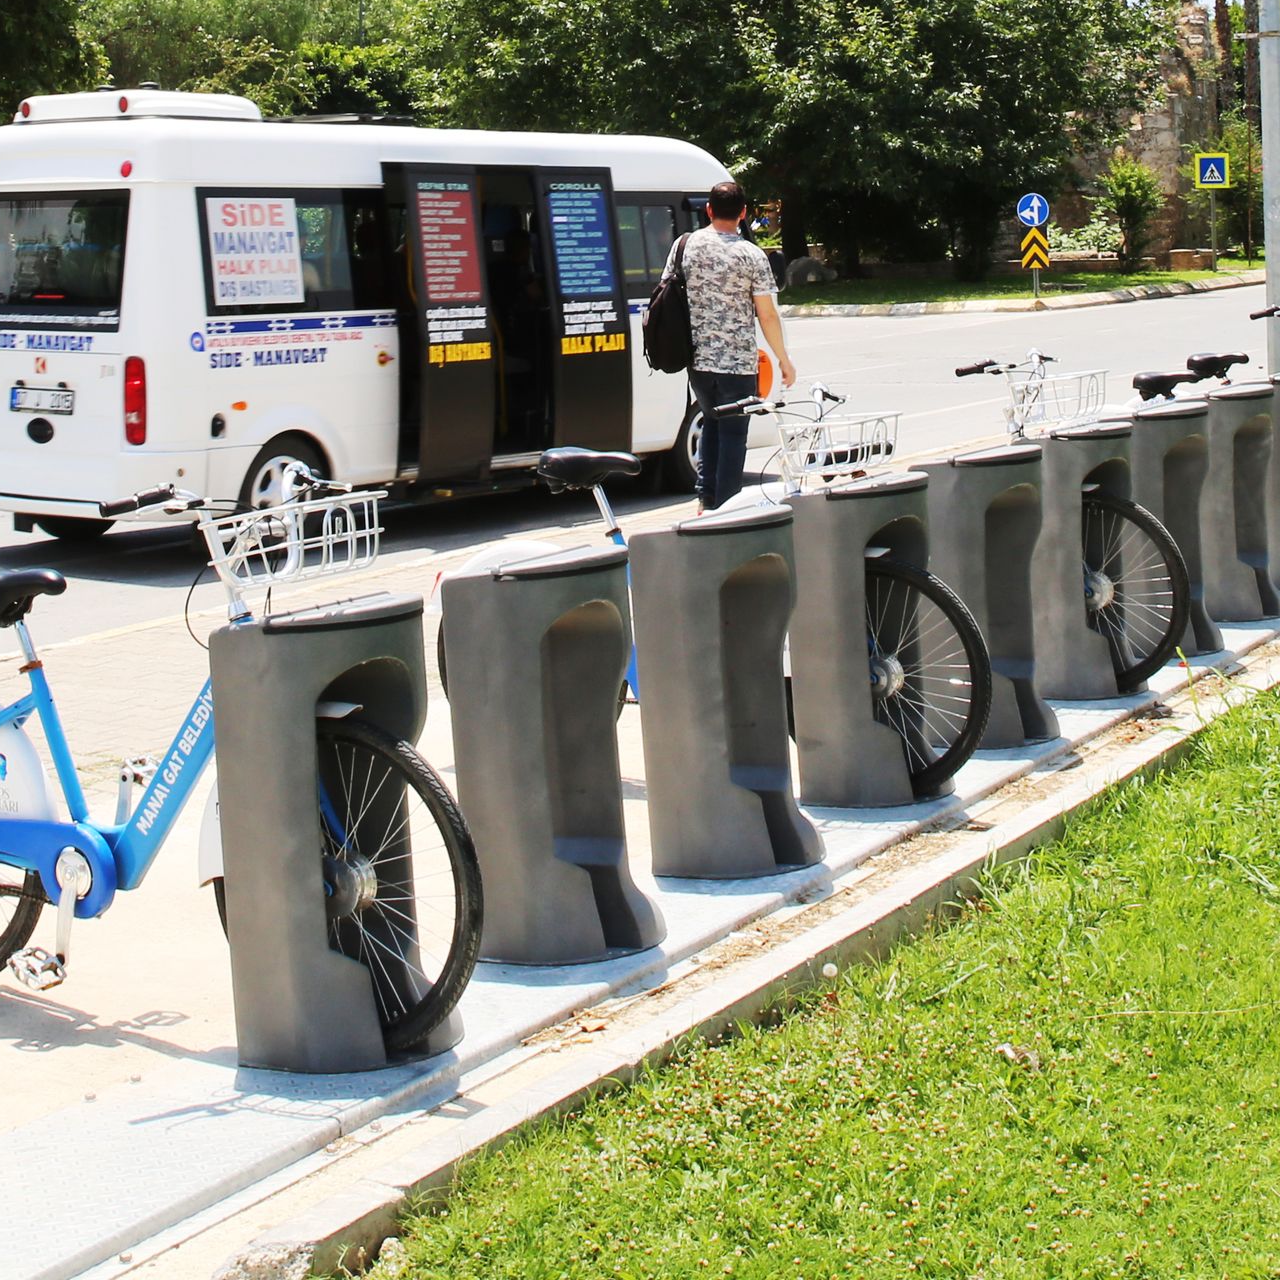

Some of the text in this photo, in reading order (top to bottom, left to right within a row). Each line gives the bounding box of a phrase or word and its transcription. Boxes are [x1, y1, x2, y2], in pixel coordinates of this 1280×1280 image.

[214, 231, 294, 254] MANAVGAT
[218, 259, 255, 275] HALK
[26, 334, 93, 351] MANAVGAT
[561, 336, 593, 355] HALK
[253, 347, 328, 366] MANAVGAT
